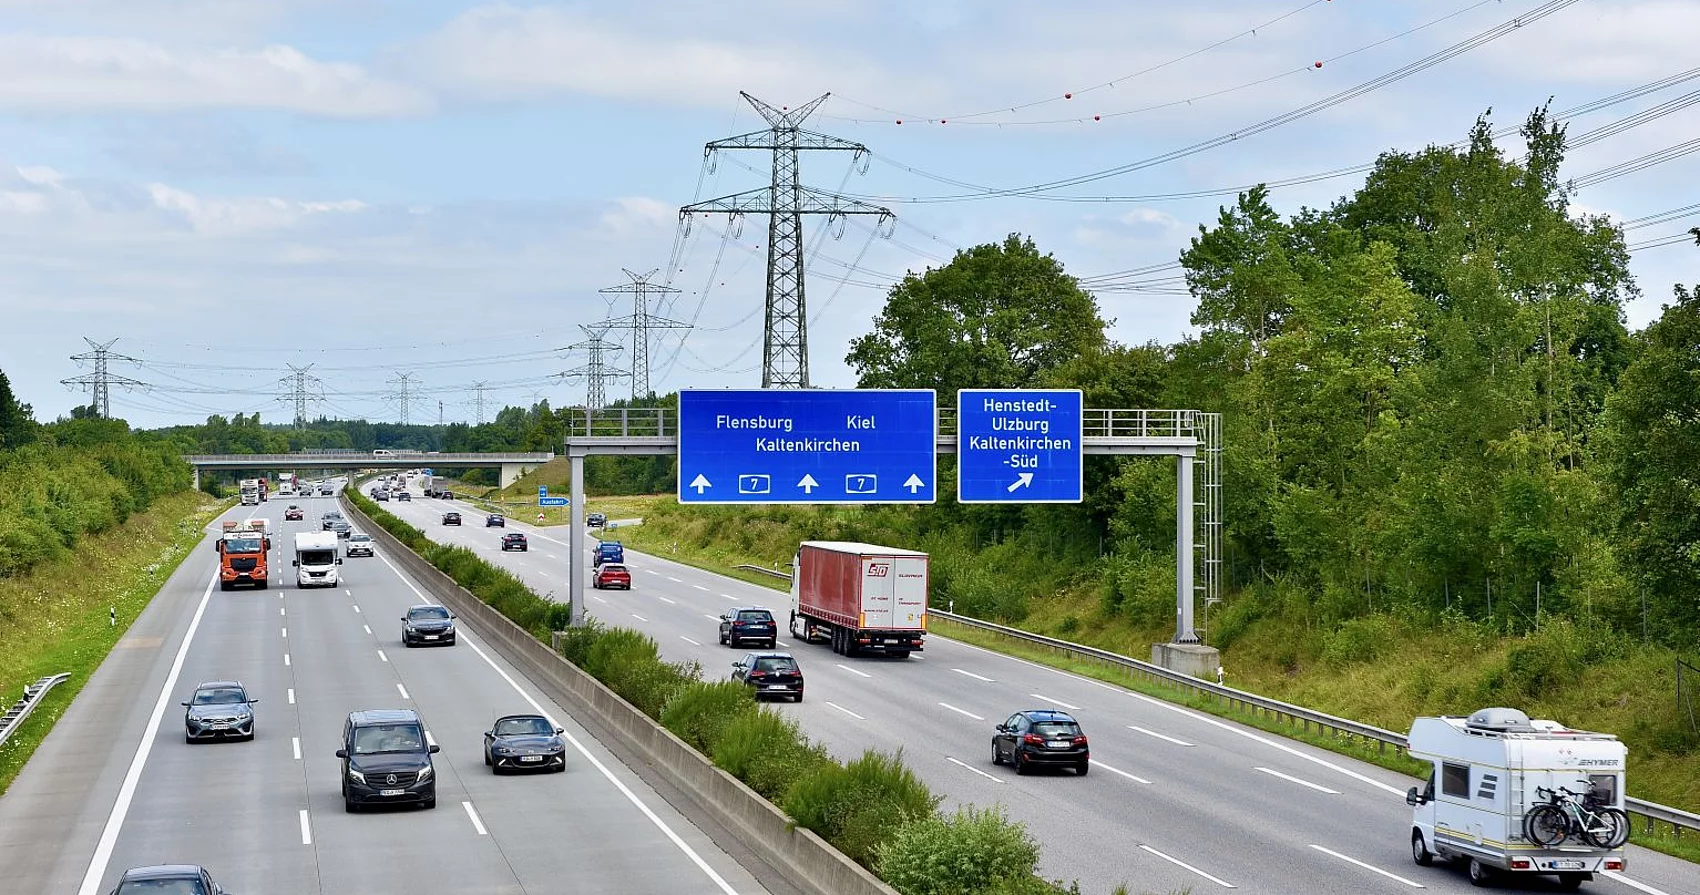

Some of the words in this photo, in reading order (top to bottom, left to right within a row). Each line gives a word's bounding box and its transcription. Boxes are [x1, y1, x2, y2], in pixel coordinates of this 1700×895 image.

[984, 399, 1058, 412] Henstedt-
[716, 415, 793, 433] Flensburg
[847, 415, 876, 430] Kiel
[992, 417, 1049, 434] Ulzburg
[756, 437, 860, 452] Kaltenkirchen
[969, 436, 1071, 450] Kaltenkirchen
[1003, 454, 1038, 469] -Süd
[750, 477, 759, 491] 7
[857, 477, 866, 491] 7
